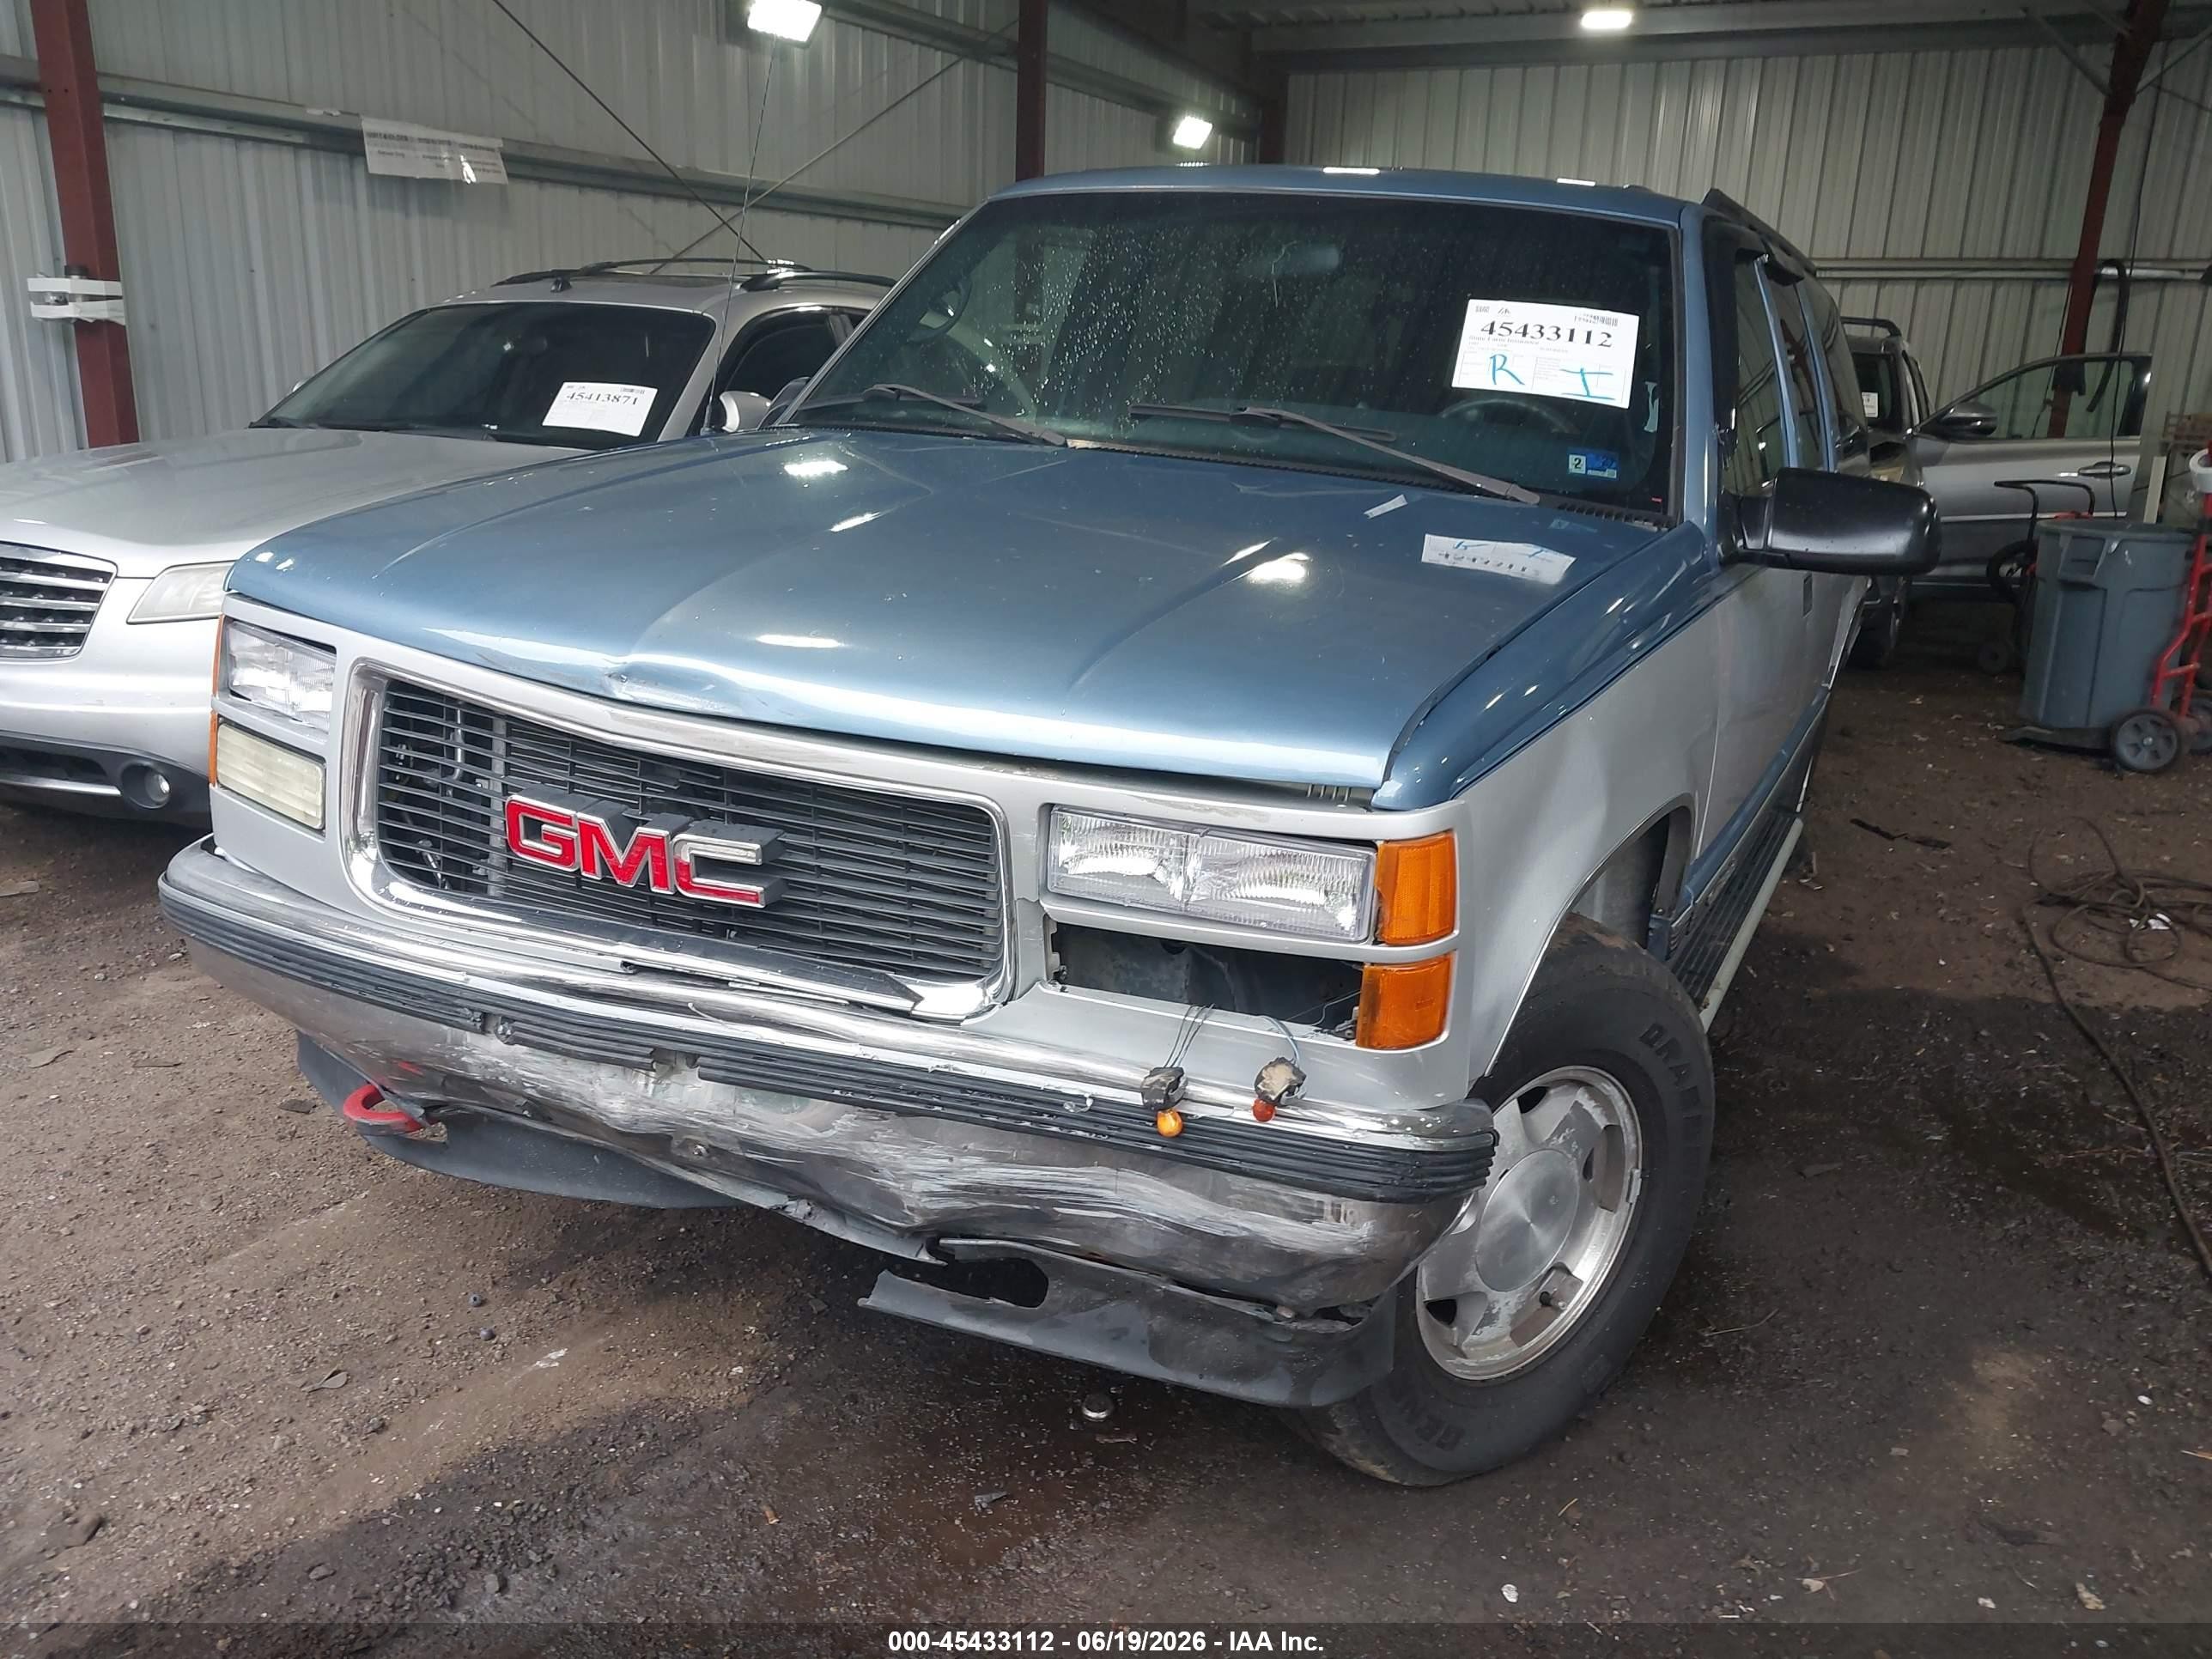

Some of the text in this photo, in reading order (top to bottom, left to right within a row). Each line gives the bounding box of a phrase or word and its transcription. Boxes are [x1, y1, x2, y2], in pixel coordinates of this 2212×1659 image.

[1481, 320, 1613, 348] 45433112
[1489, 353, 1525, 386] R
[566, 392, 639, 405] 45413871
[1573, 457, 1583, 470] 2
[505, 794, 766, 908] GMC
